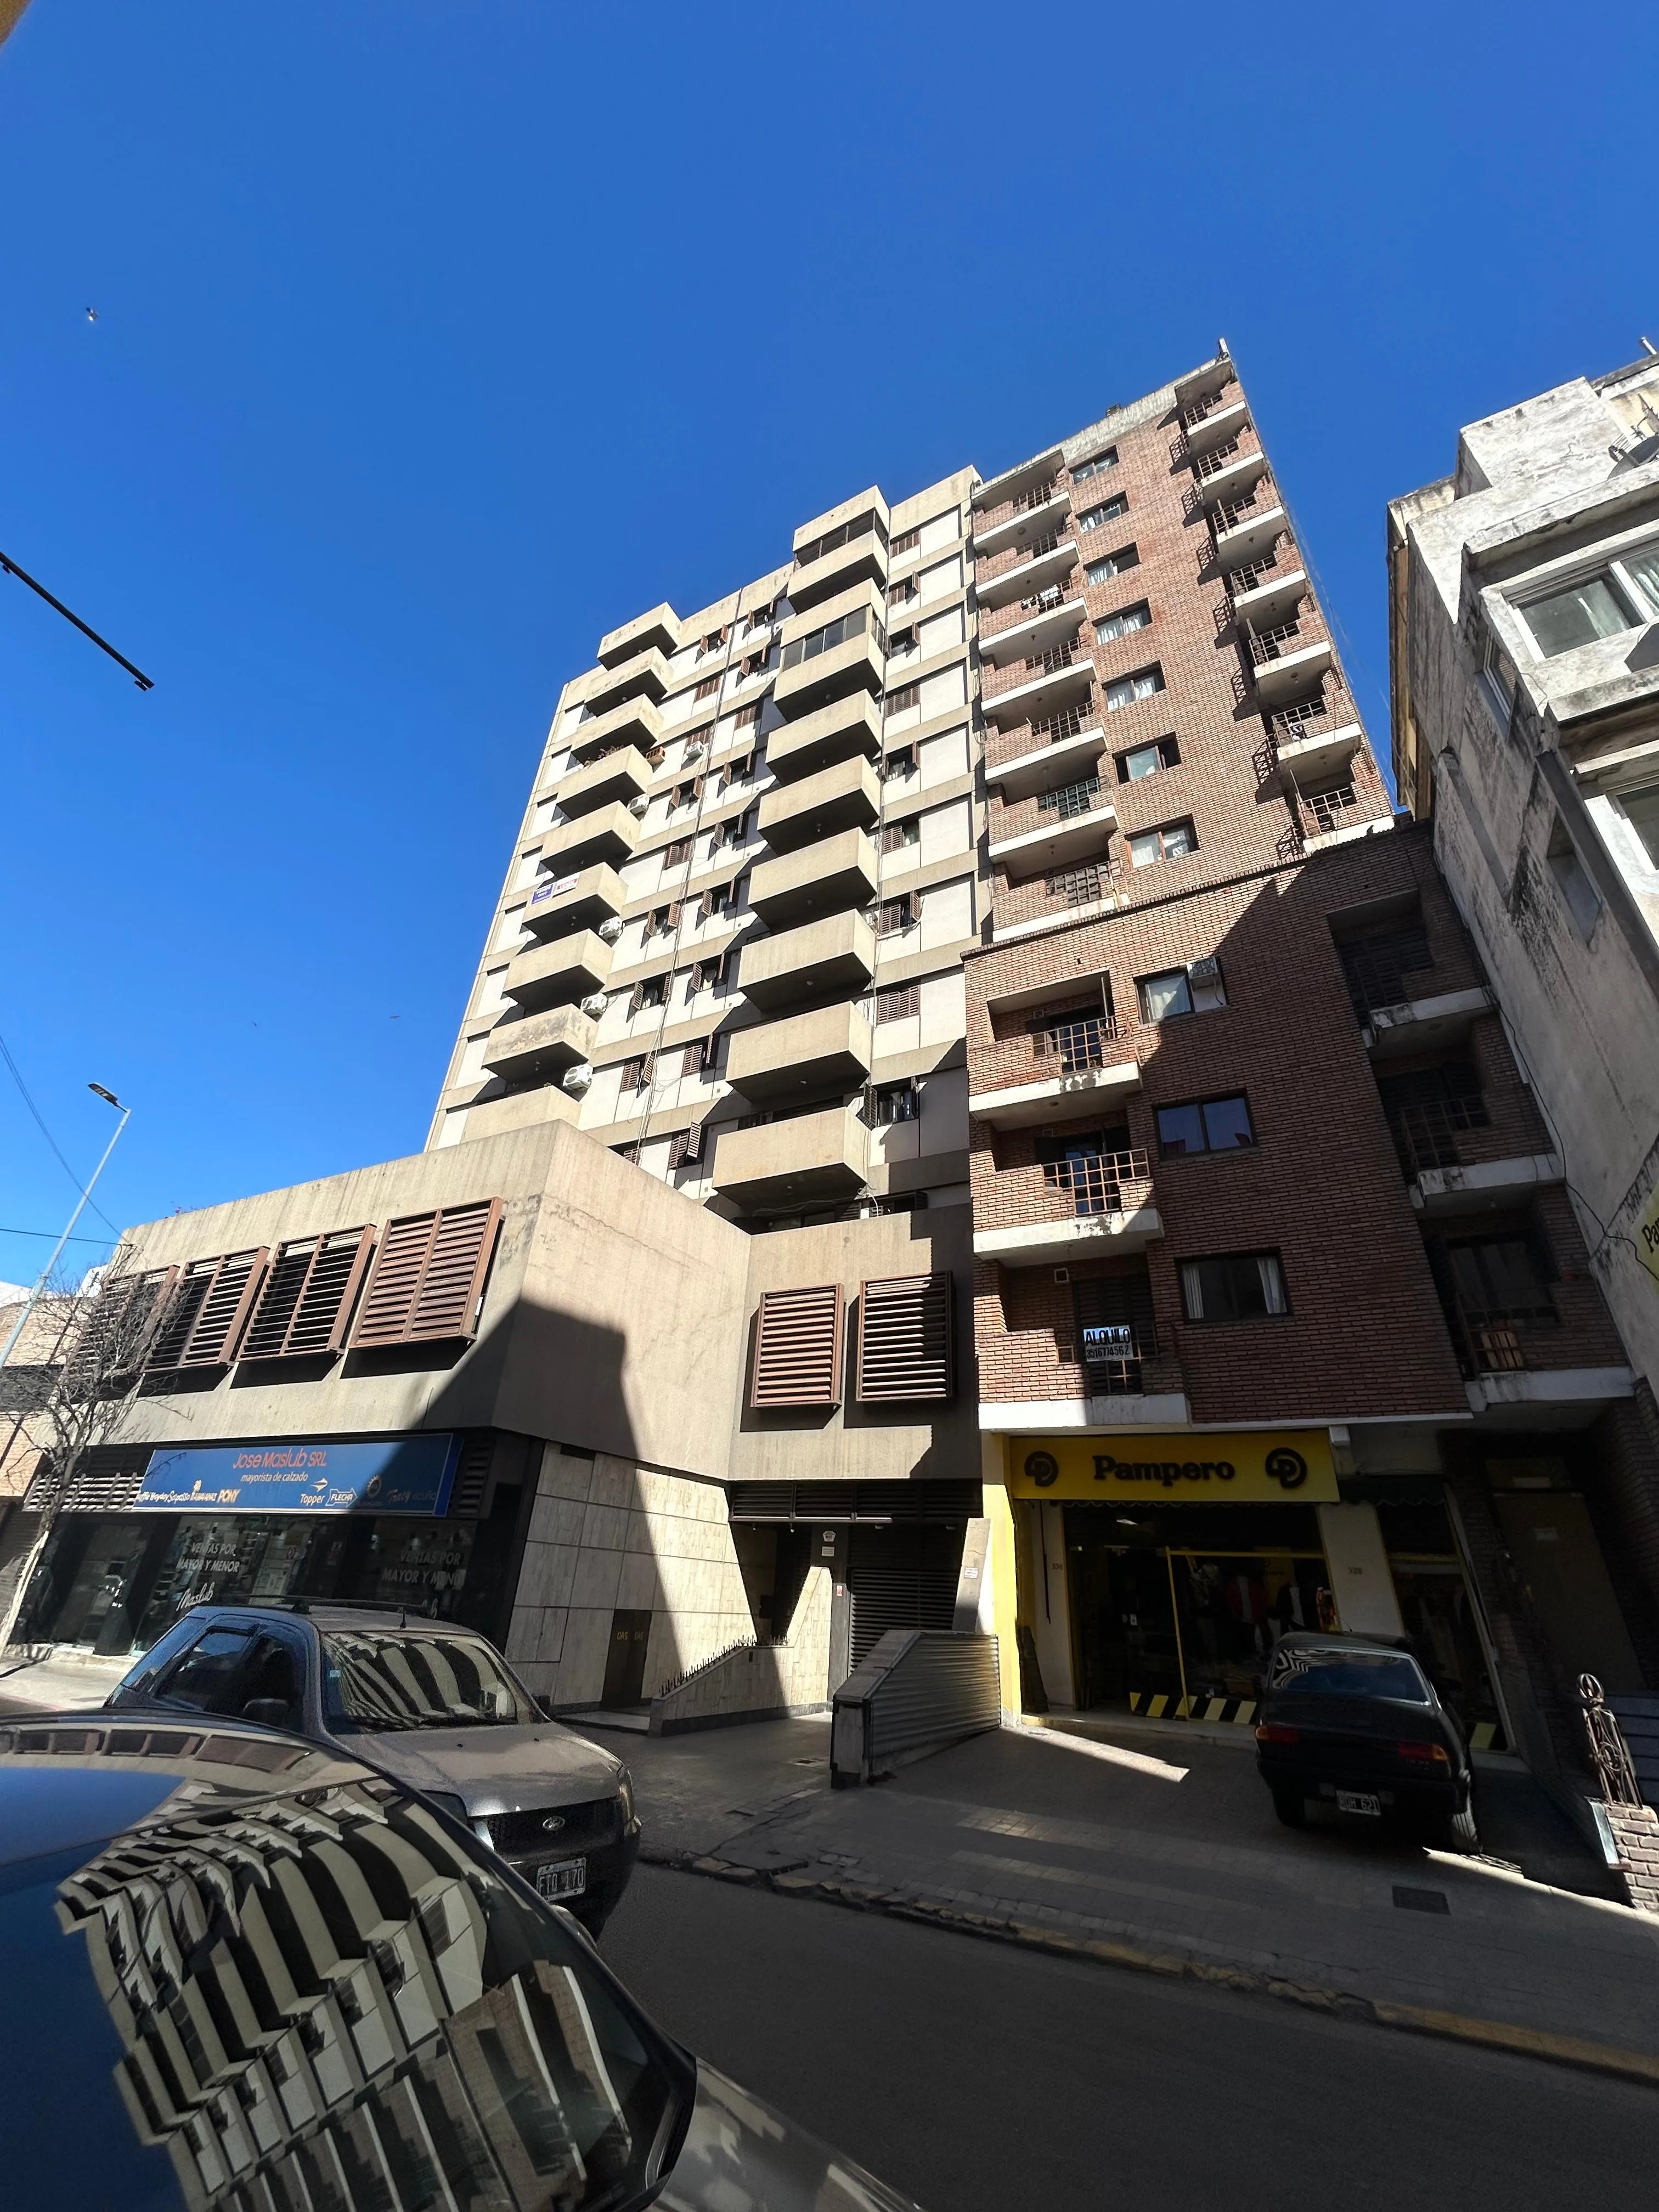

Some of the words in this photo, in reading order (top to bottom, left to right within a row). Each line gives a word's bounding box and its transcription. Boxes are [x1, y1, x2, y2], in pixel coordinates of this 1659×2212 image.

[1086, 1328, 1130, 1346] ALQUILO
[233, 1453, 262, 1469] Jose
[261, 1447, 307, 1468] Maslub
[307, 1451, 327, 1467] SRL
[240, 1472, 272, 1485] mayorista
[273, 1471, 282, 1482] de
[282, 1471, 308, 1482] calzado
[1092, 1455, 1236, 1487] Pampero
[217, 1488, 241, 1503] PONY
[300, 1493, 325, 1506] Topper
[330, 1493, 354, 1502] FLECHA
[191, 1542, 219, 1554] VENTAS
[219, 1543, 236, 1555] POR
[176, 1559, 204, 1571] MAYOR
[204, 1560, 212, 1571] Y
[211, 1560, 240, 1572] MENOR
[439, 1552, 461, 1565] POR
[381, 1567, 420, 1583] MAYOR
[422, 1571, 430, 1583] Y
[176, 1581, 216, 1612] Maslub
[1361, 1798, 1379, 1812] 621
[565, 1867, 584, 1889] 170
